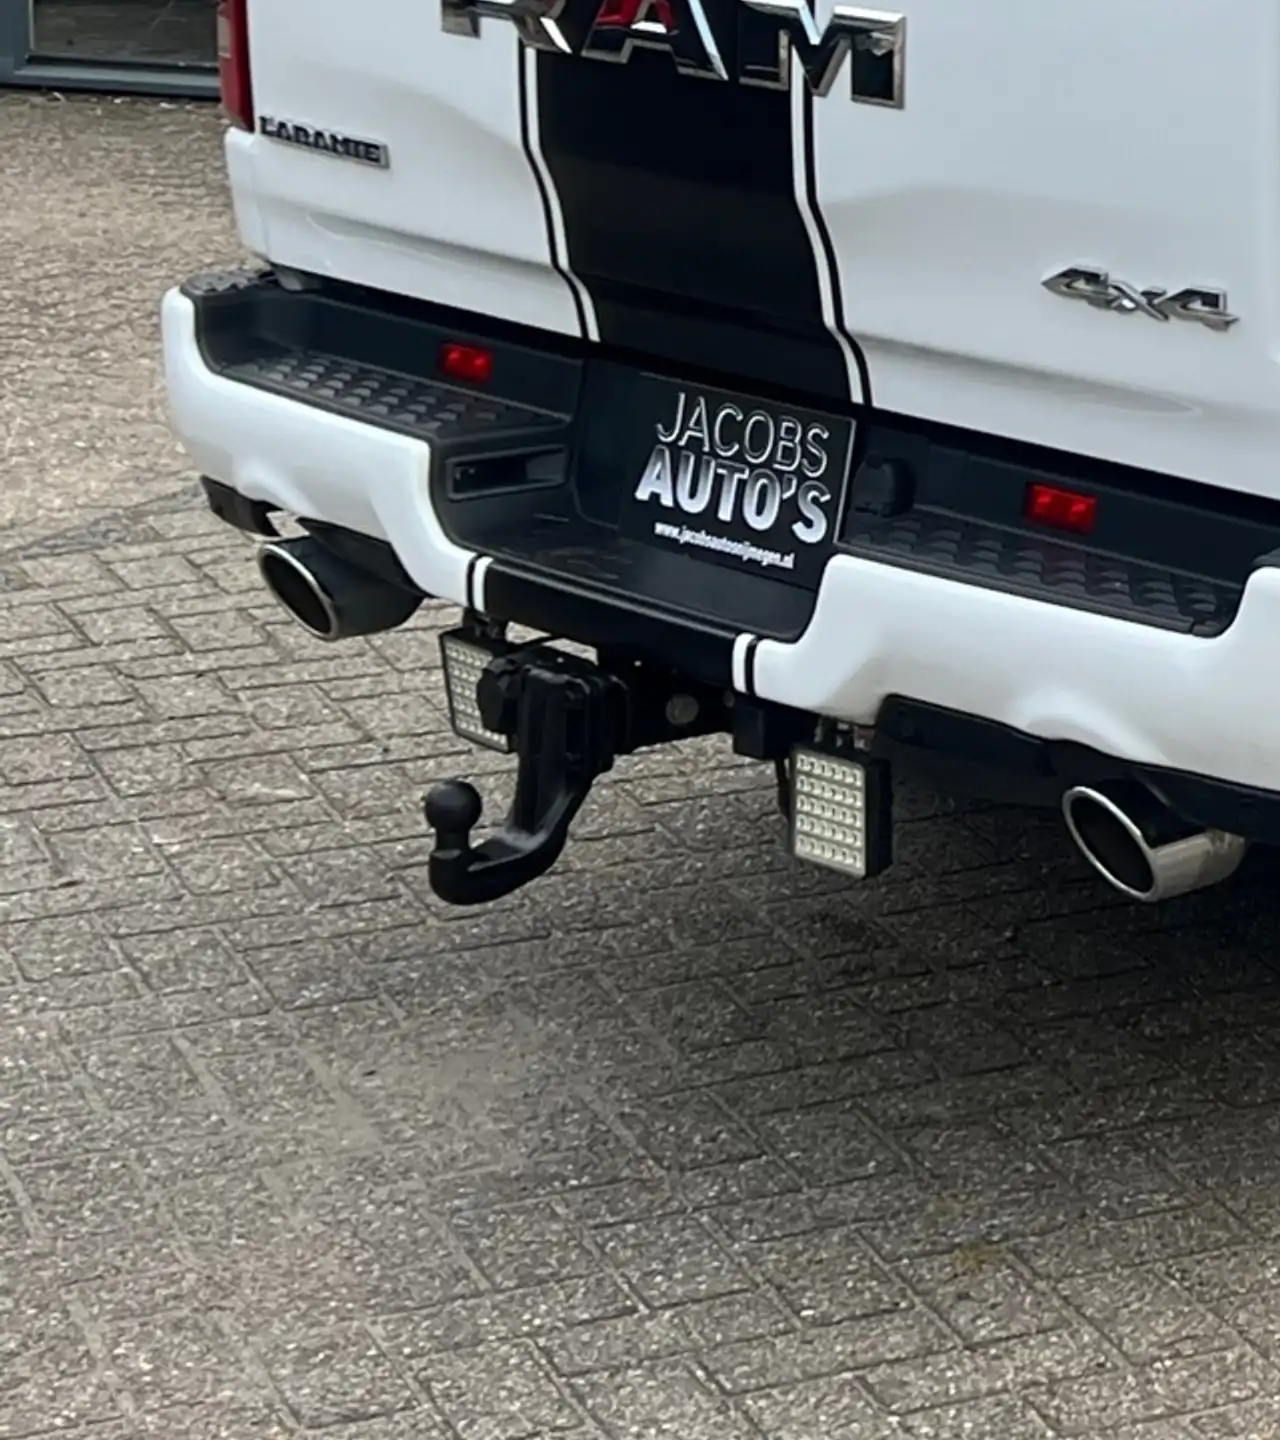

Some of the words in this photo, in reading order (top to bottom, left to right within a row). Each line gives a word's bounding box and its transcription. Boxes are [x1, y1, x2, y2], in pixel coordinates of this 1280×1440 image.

[259, 116, 387, 167] LARAMIE
[655, 391, 830, 478] JACOBS
[634, 444, 832, 544] AUTO'S
